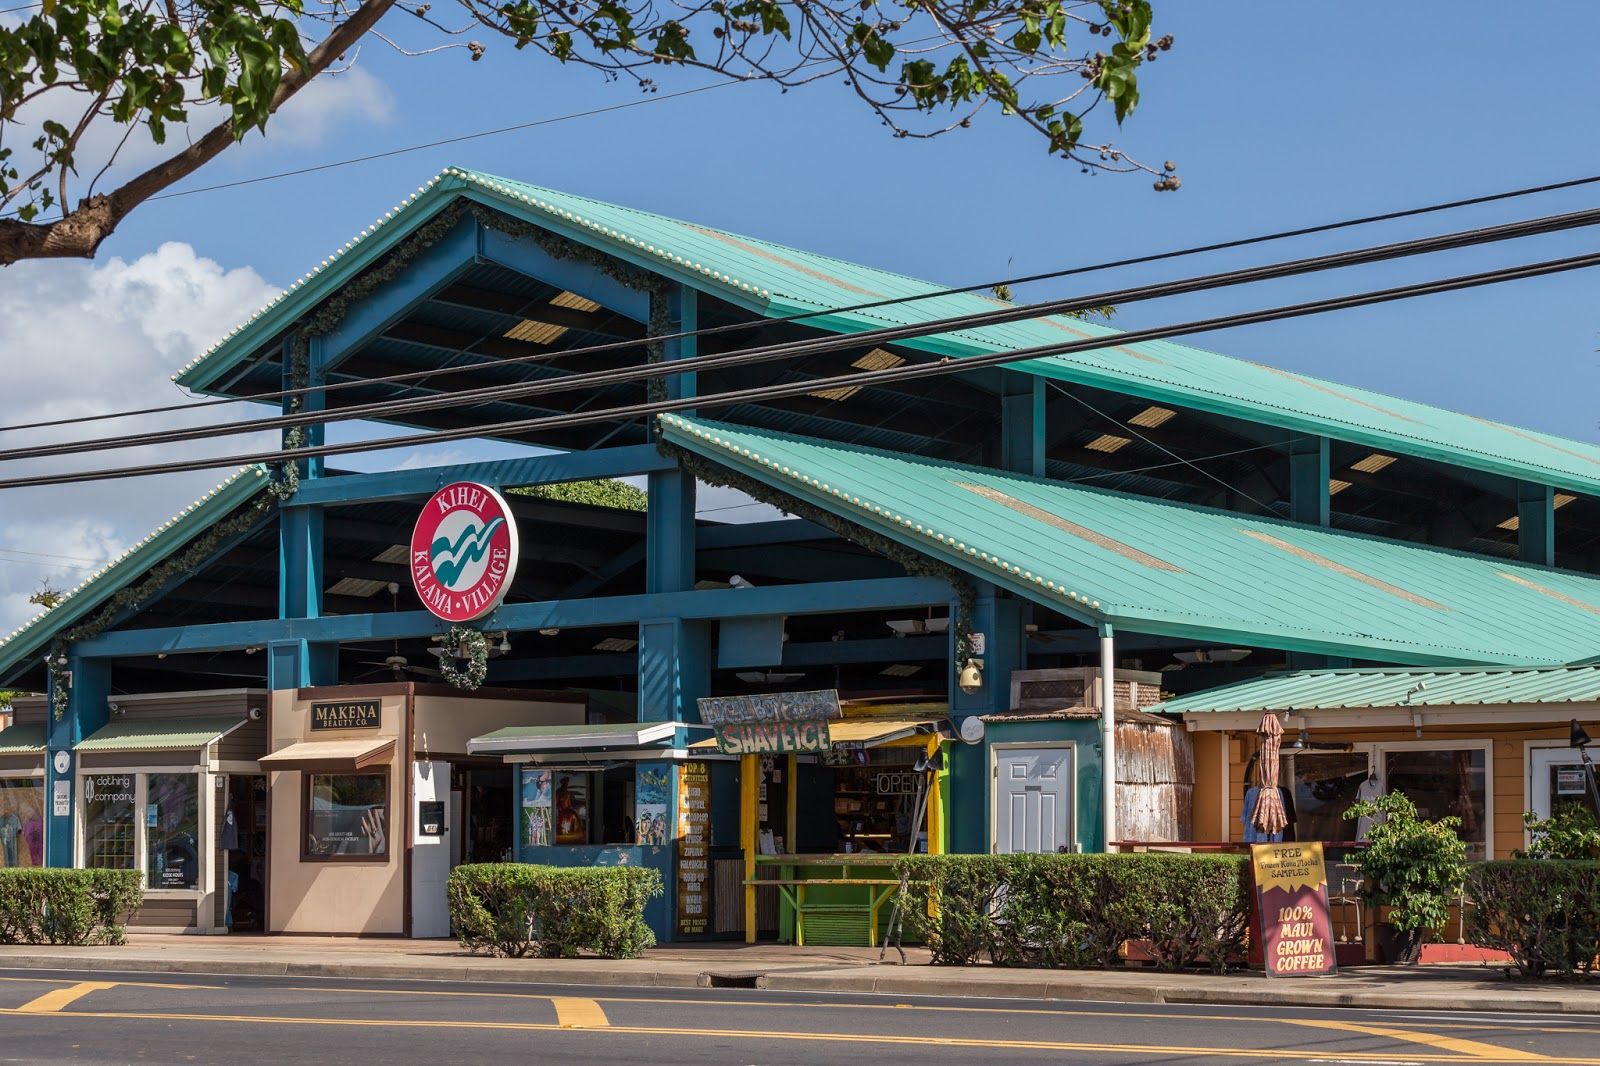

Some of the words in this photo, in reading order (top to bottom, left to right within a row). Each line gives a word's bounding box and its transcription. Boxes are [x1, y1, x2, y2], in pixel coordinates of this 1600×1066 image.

[436, 487, 489, 514] KIHEI
[414, 550, 452, 614] KALAMA
[461, 548, 508, 613] VILLAGE
[316, 705, 377, 720] MAKENA
[683, 763, 697, 773] TOP
[700, 763, 705, 774] 8
[96, 776, 130, 788] clothing
[879, 774, 925, 793] OPEN
[94, 793, 136, 804] company
[1273, 848, 1302, 858] FREE
[1271, 868, 1310, 878] SAMPLES
[1278, 905, 1313, 922] 100%
[1280, 922, 1314, 938] MAUI
[1276, 938, 1324, 956] GROWN
[1276, 954, 1324, 972] COFFEE
